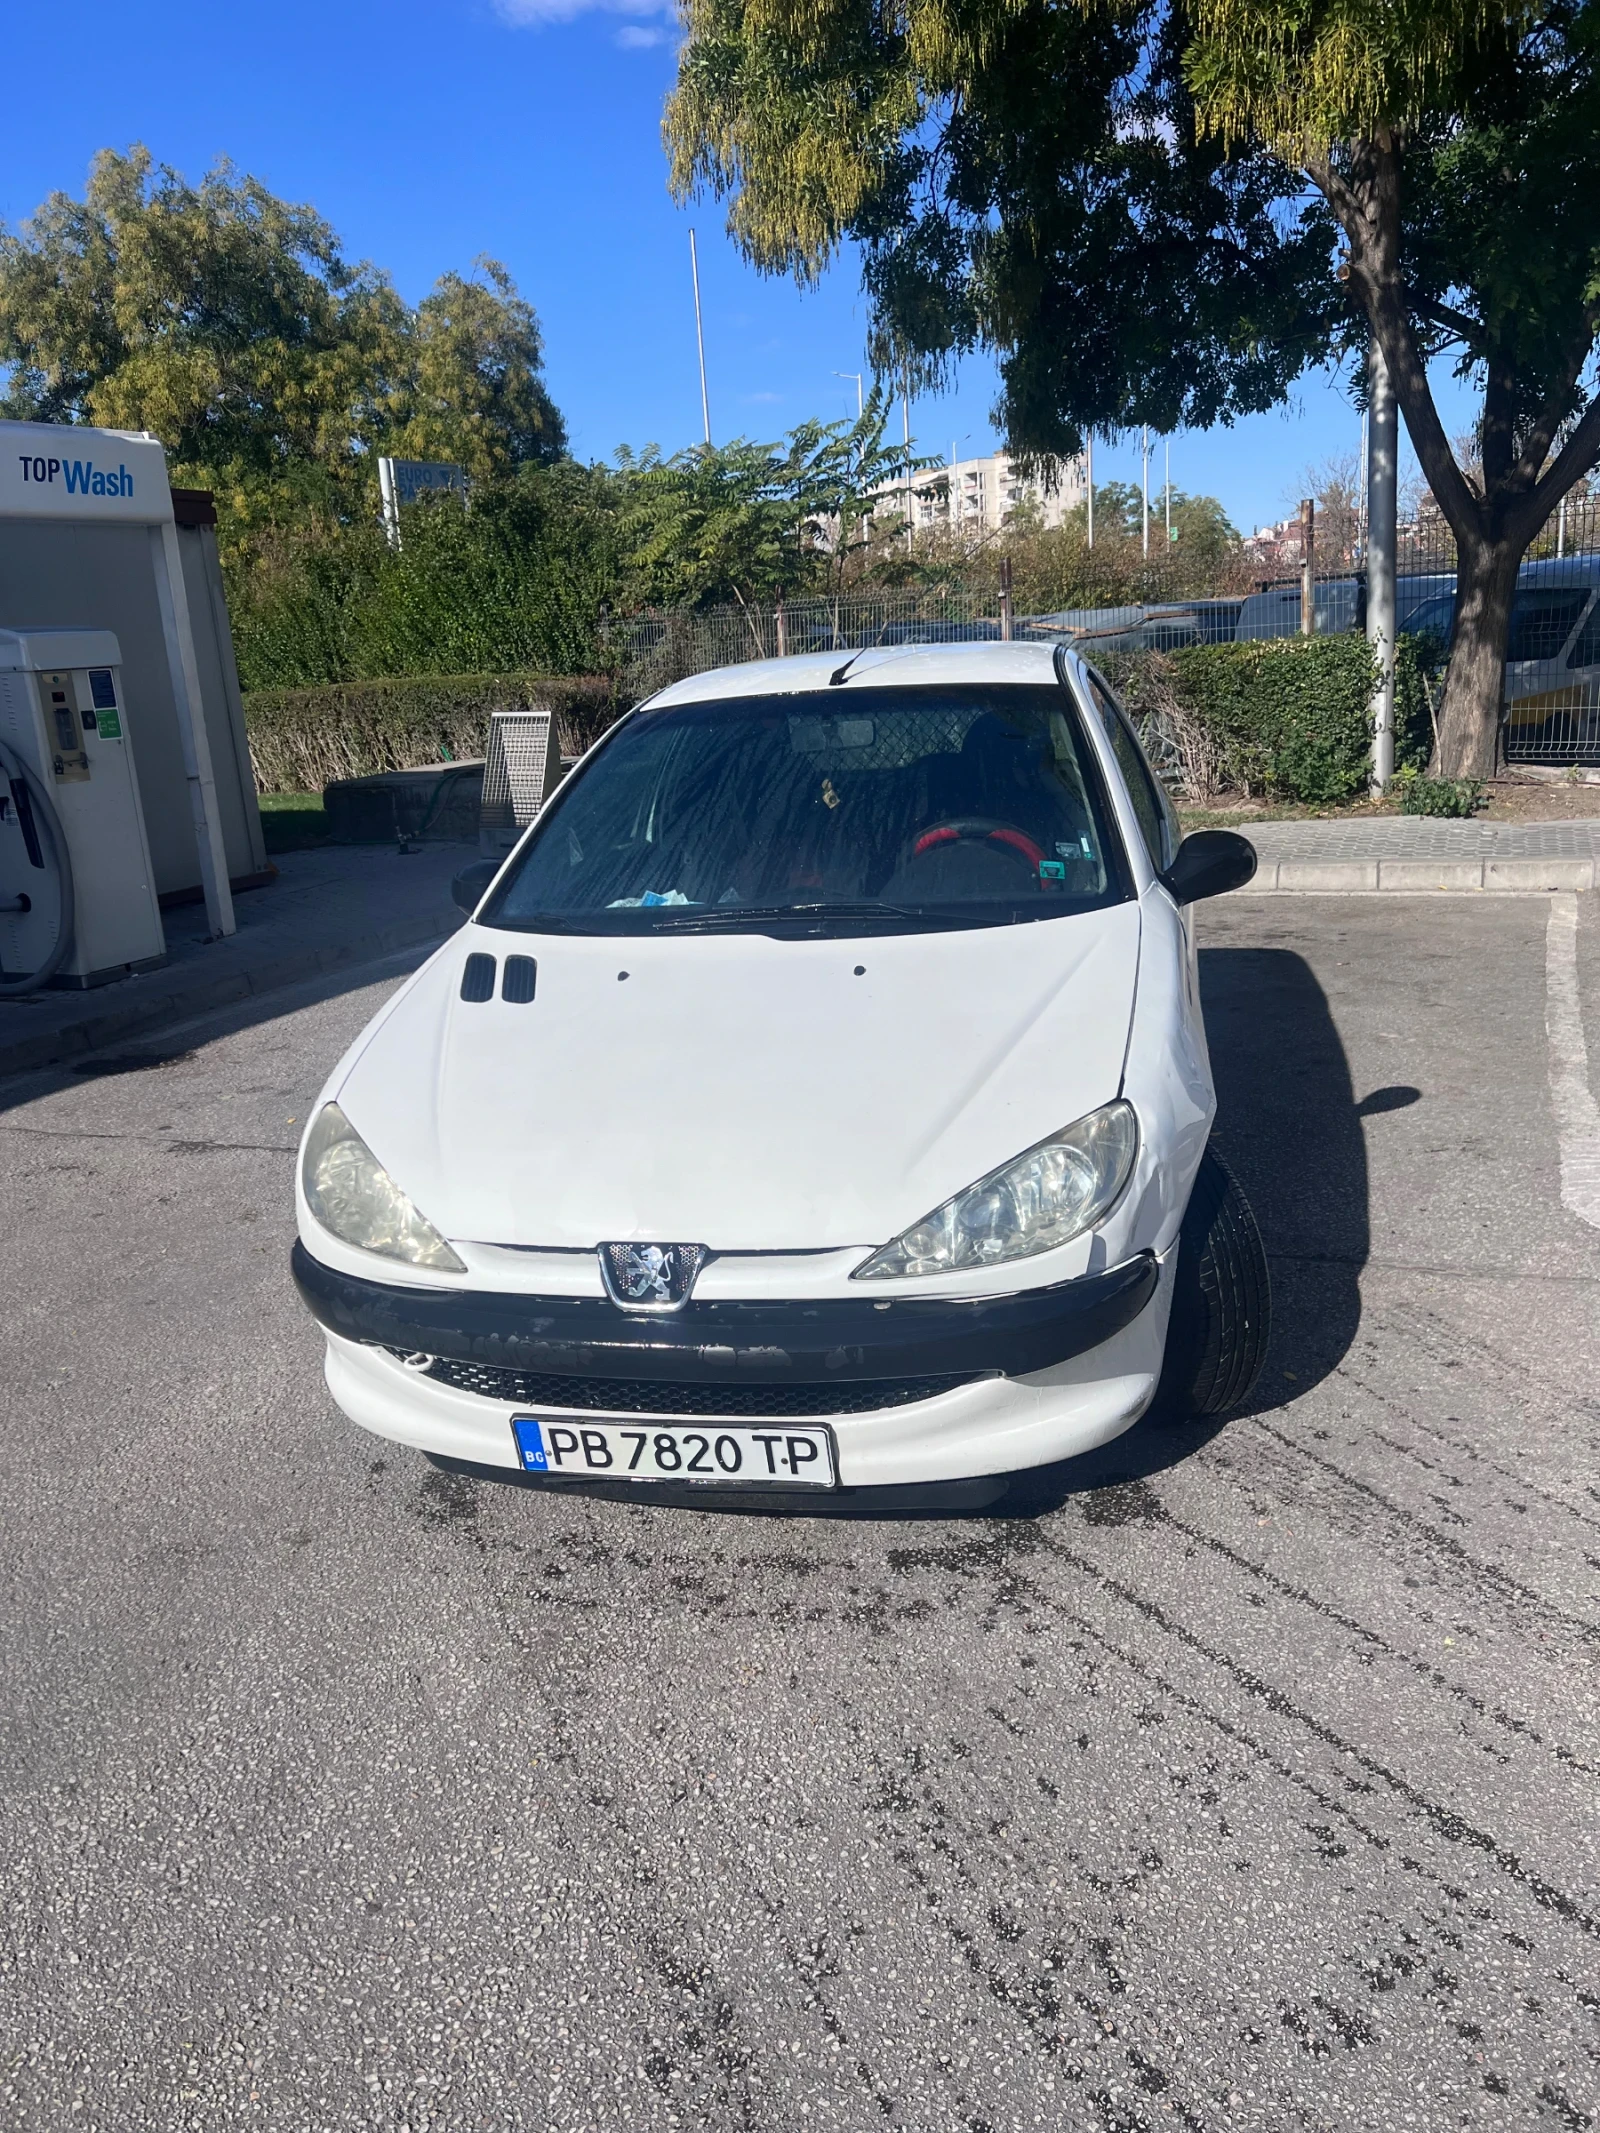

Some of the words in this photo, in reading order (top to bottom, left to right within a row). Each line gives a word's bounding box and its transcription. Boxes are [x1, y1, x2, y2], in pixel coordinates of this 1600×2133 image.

[19, 456, 60, 483] TOP
[62, 459, 134, 497] Wash
[397, 465, 433, 484] EURO
[524, 1450, 545, 1463] BG
[548, 1428, 613, 1468] PB
[620, 1432, 743, 1473] 7820
[752, 1435, 819, 1475] TP
